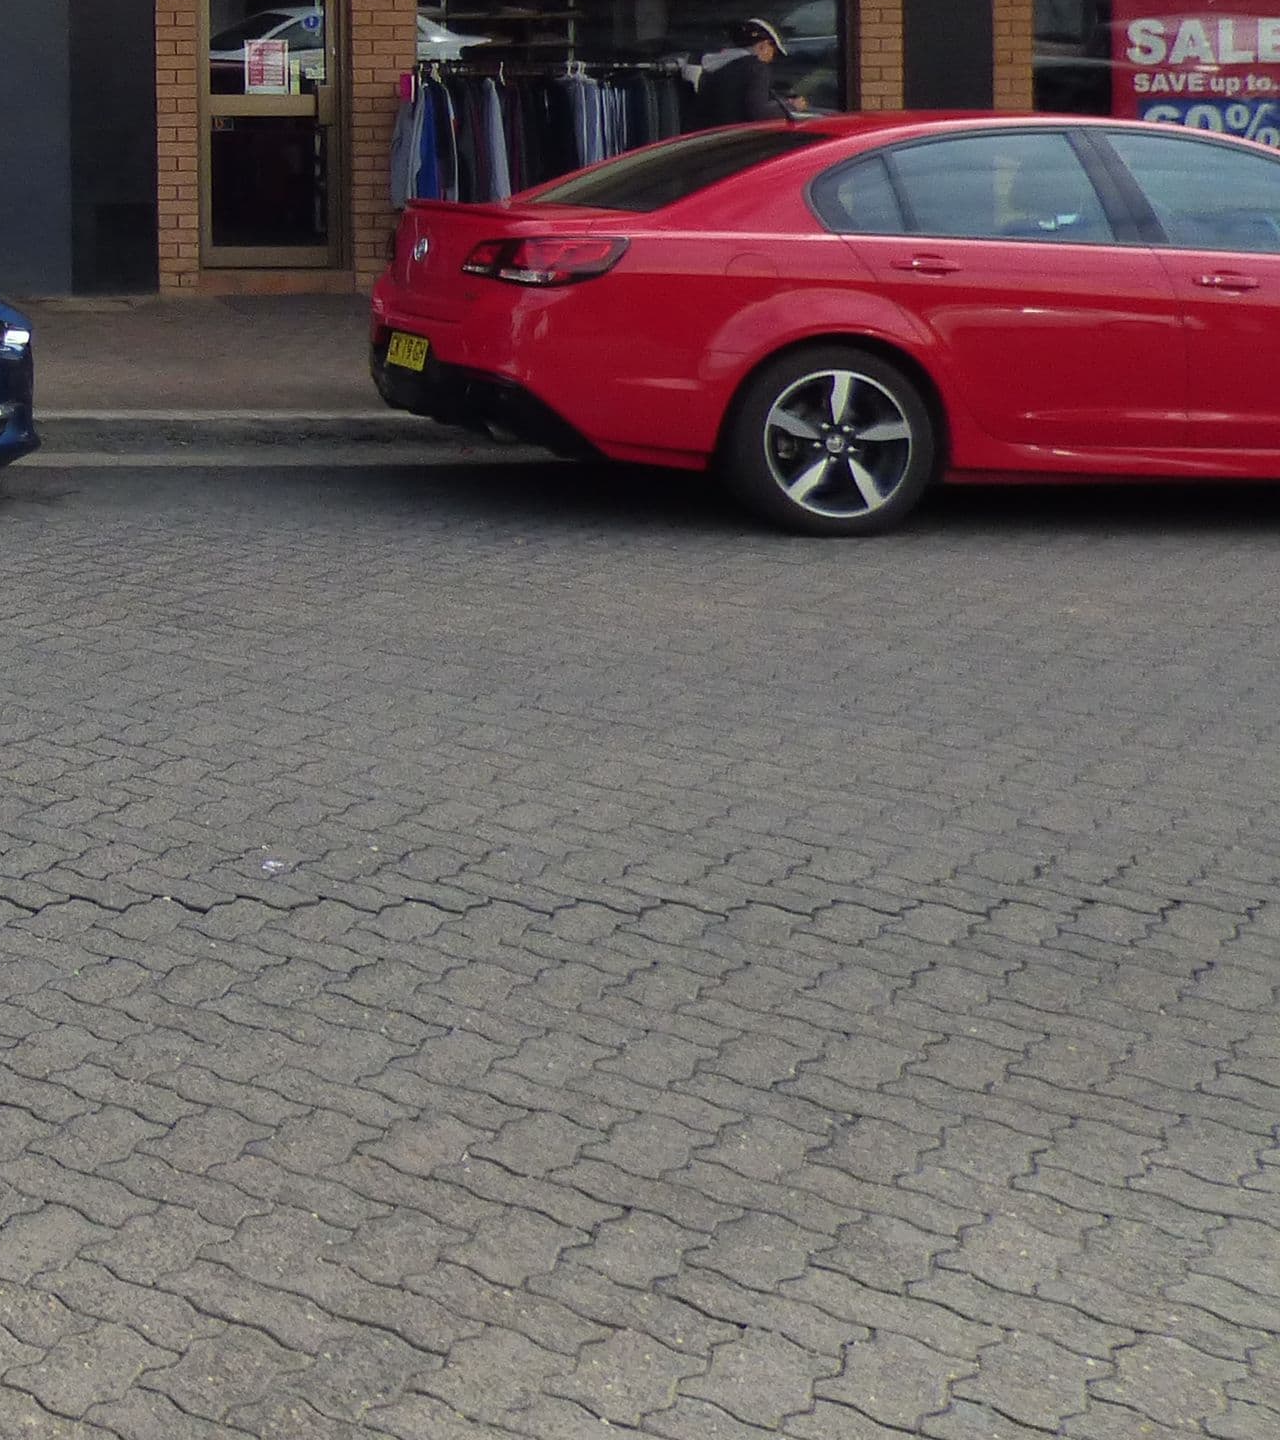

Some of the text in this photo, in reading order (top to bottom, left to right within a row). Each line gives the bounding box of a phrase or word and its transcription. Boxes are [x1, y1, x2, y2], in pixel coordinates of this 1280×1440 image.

[1127, 19, 1280, 66] SALE
[1134, 72, 1206, 93] SAVE
[1211, 76, 1241, 95] up
